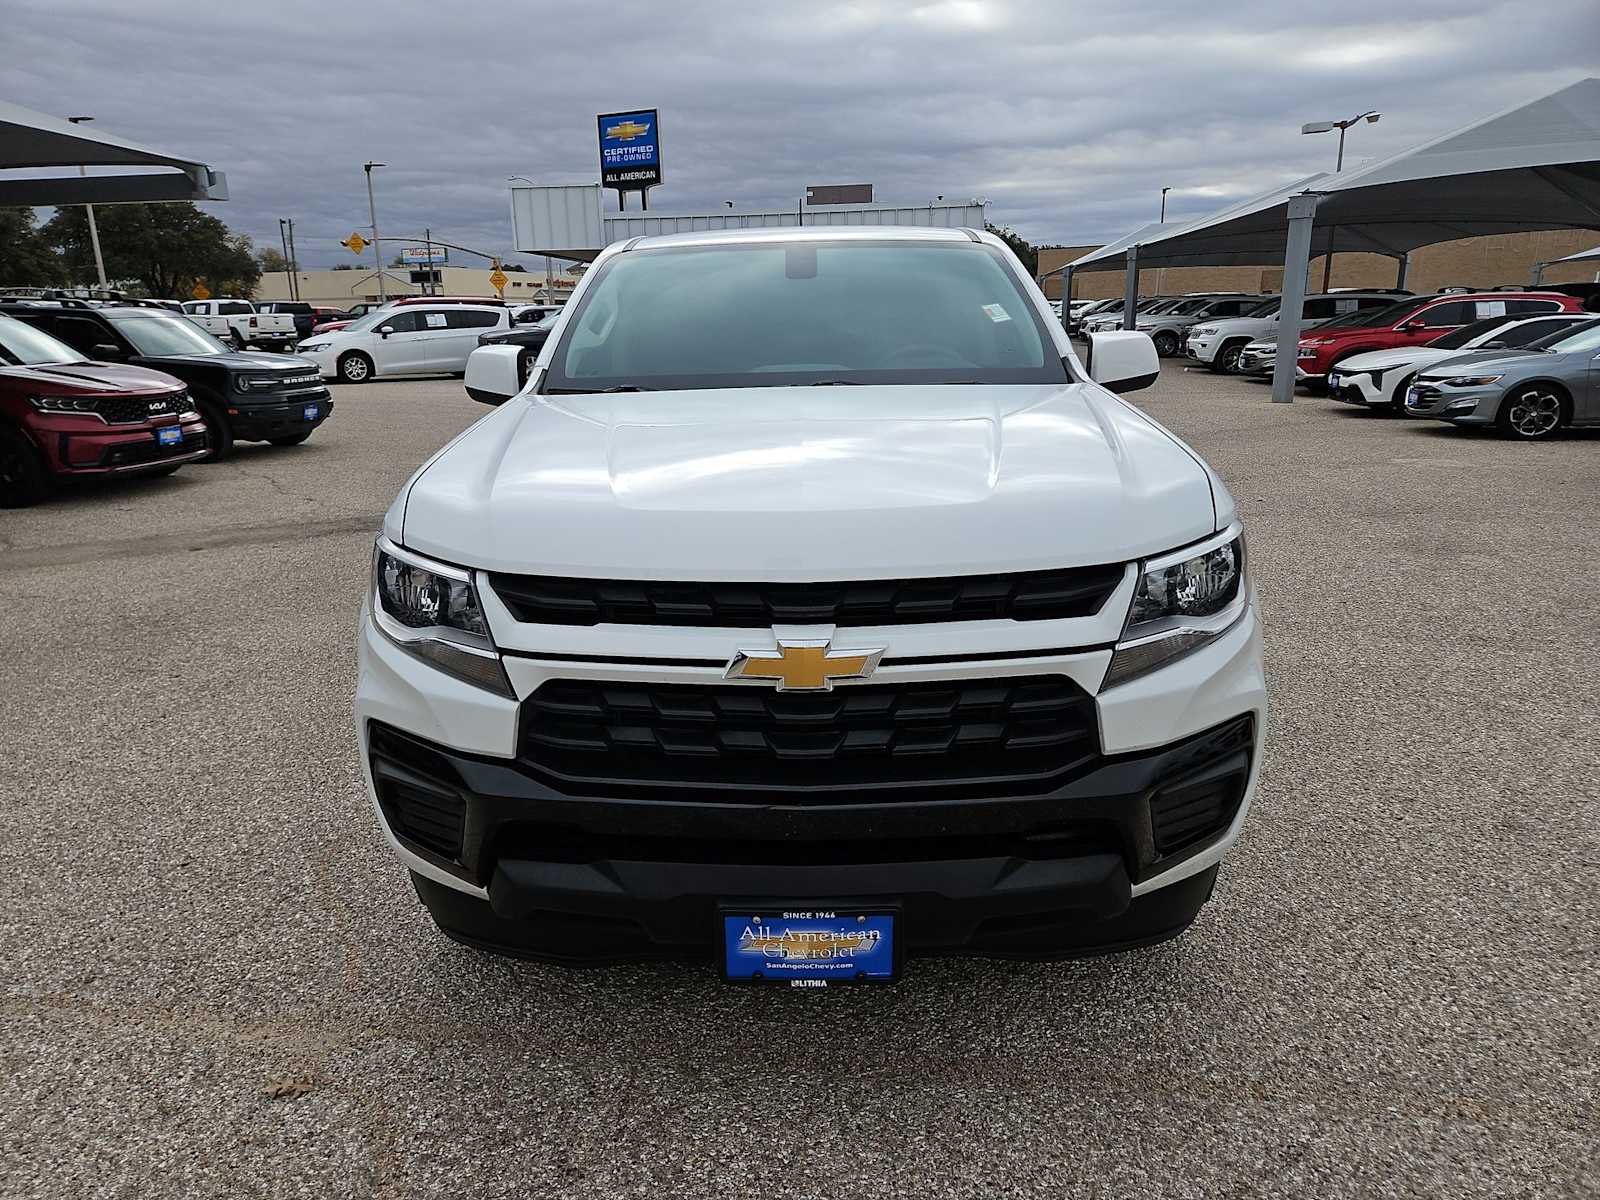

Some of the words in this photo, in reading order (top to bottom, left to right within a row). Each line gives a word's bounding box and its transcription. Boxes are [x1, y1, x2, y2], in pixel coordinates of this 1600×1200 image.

[604, 145, 654, 156] CERTIFIED
[606, 152, 652, 163] PRE-OWNED
[606, 174, 619, 182] ALL
[620, 170, 656, 181] AMERICAN
[149, 402, 166, 410] KIA
[739, 925, 771, 941] All
[780, 927, 881, 942] American
[762, 942, 857, 959] Chevrolet
[766, 962, 853, 971] SanAngeloChevy.com
[800, 979, 828, 987] LITHIA
